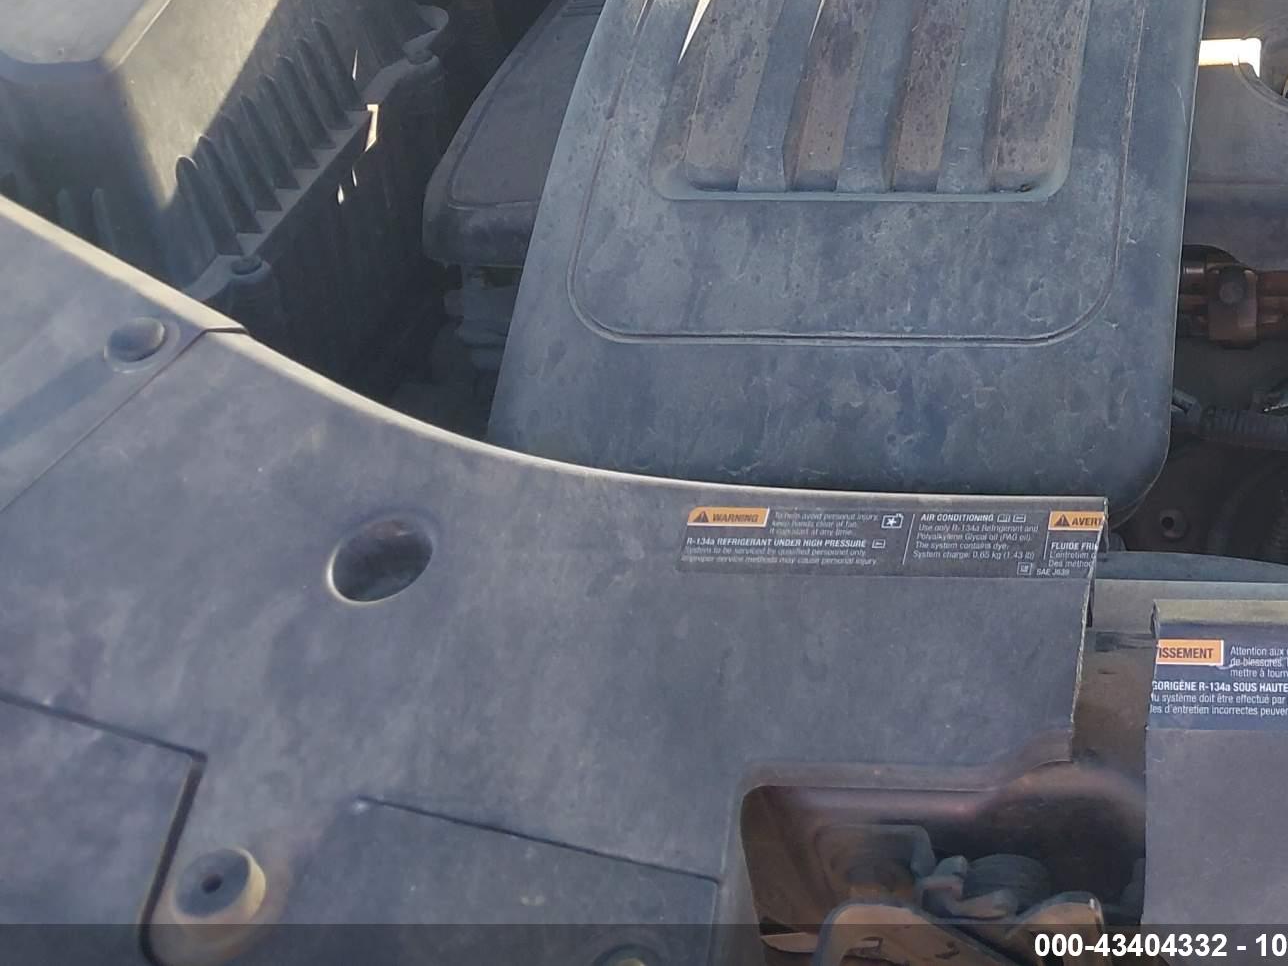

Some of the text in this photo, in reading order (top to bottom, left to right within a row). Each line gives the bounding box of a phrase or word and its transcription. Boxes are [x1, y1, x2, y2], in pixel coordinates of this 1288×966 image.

[712, 513, 759, 522] WARNING
[920, 514, 994, 522] AIR CONDITIONING
[686, 537, 866, 547] R-134a REFRIGERANT UNDER HIGH PRESSURE
[1050, 542, 1080, 550] FLUIDE
[1230, 646, 1267, 655] Attention
[1230, 658, 1241, 666] de
[1230, 669, 1257, 677] mettre
[1198, 682, 1231, 692] R-134a
[1233, 682, 1257, 692] SOUS
[1259, 682, 1288, 692] HAUTE
[1162, 693, 1197, 705] système
[1199, 694, 1215, 703] doit
[1216, 694, 1234, 703] être
[1235, 694, 1270, 704] effectué
[1271, 696, 1286, 706] par
[1164, 705, 1209, 714] d'entretien
[1211, 705, 1258, 714] incorrectes
